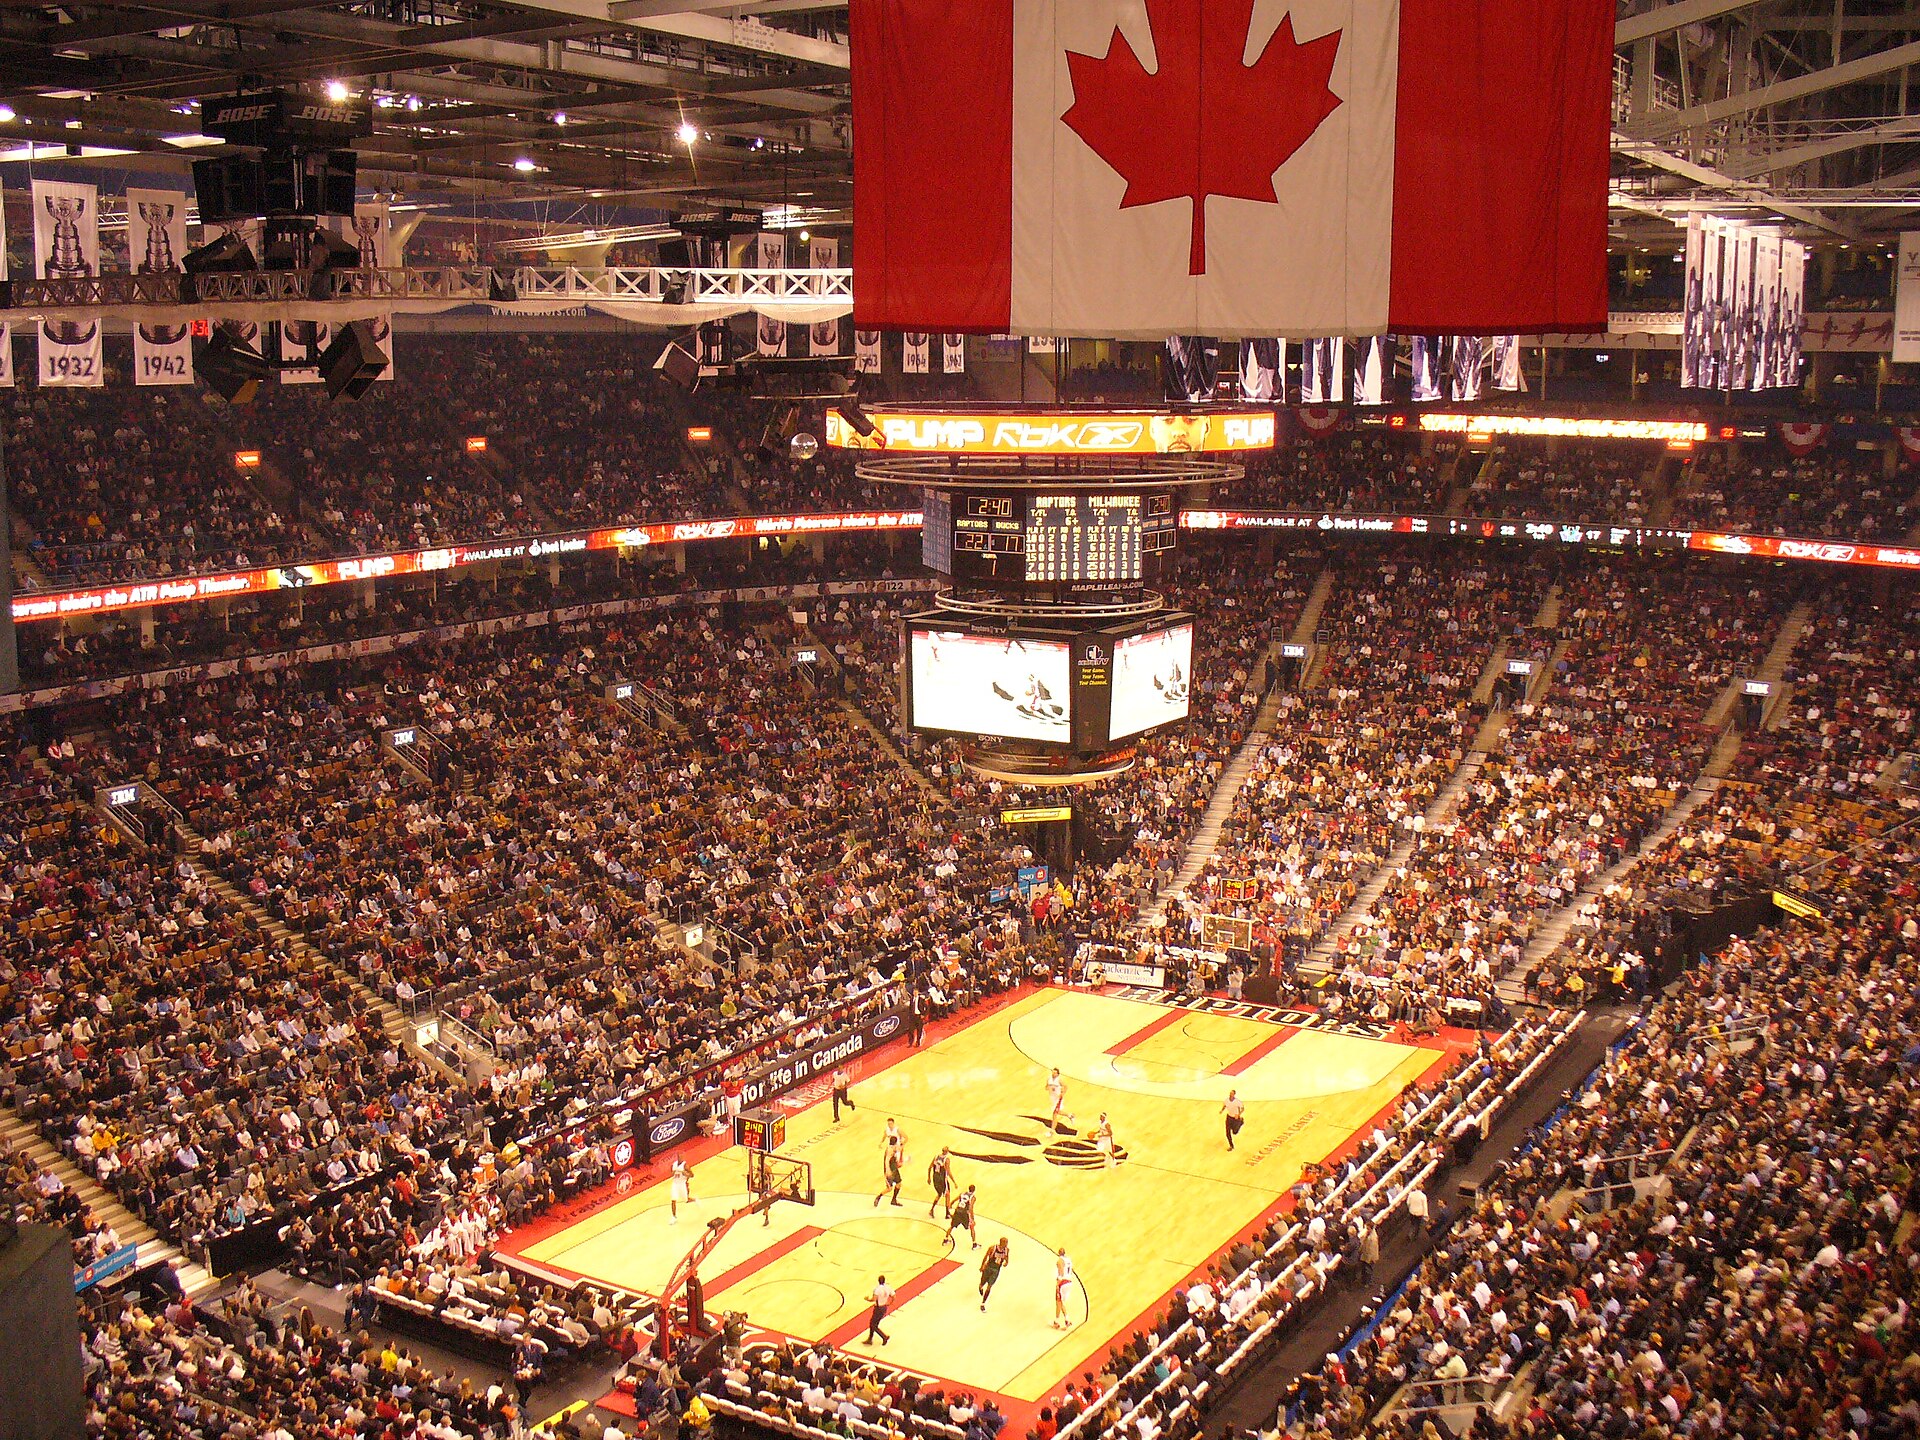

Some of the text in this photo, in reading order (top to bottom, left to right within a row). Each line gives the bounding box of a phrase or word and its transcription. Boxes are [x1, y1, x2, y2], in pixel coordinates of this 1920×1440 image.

[212, 105, 274, 124] BOSE
[296, 105, 363, 123] BOSE
[675, 213, 718, 223] BOSE
[727, 213, 760, 223] BOSE
[49, 356, 94, 377] 1932
[143, 356, 186, 377] 1942
[1392, 416, 1404, 426] 22
[883, 418, 986, 449] PUMP
[1721, 427, 1734, 437] 22
[978, 499, 1010, 515] 2:40
[1036, 496, 1076, 508] RAPTORS
[1088, 496, 1140, 508] MILWAUKEE
[956, 519, 988, 529] RAPTORS
[1035, 517, 1043, 526] 2
[1097, 517, 1105, 526] 2
[1235, 517, 1296, 527] AVAILABLE
[1297, 518, 1313, 527] AT
[965, 533, 984, 550] 22
[1005, 535, 1019, 552] 17
[1048, 534, 1054, 542] 2
[1073, 534, 1080, 542] 2
[1086, 534, 1140, 542] 31 1 3 3 1
[462, 547, 510, 562] AVAILABLE
[511, 545, 525, 557] AT
[1026, 543, 1037, 552] 11
[1048, 543, 1054, 552] 2
[1060, 543, 1068, 552] 1
[1073, 543, 1080, 552] 2
[1086, 543, 1098, 552] 6
[1108, 543, 1116, 552] 2
[1134, 543, 1140, 552] 1
[1026, 552, 1037, 561] 15
[1060, 552, 1068, 561] 1
[1073, 552, 1080, 561] 1
[1086, 552, 1098, 560] 22
[1108, 552, 1116, 560] 6
[1121, 552, 1128, 560] 1
[1134, 552, 1140, 560] 1
[337, 556, 395, 581] PUMP
[1026, 562, 1037, 571] 7
[1108, 561, 1116, 570] 4
[1121, 561, 1128, 570] 3
[1026, 571, 1037, 580] 20
[130, 585, 158, 603] ATR
[797, 650, 817, 663] IBM
[616, 685, 632, 698] IBM
[394, 731, 413, 746] IBM
[978, 734, 1003, 744] SONY
[111, 788, 136, 805] IBM
[876, 1017, 898, 1036] Ford
[742, 1081, 764, 1105] for
[795, 1059, 808, 1079] in
[812, 1033, 863, 1070] Canada
[655, 1119, 682, 1142] Ford
[744, 1120, 763, 1133] 2:40
[743, 1131, 760, 1148] 22
